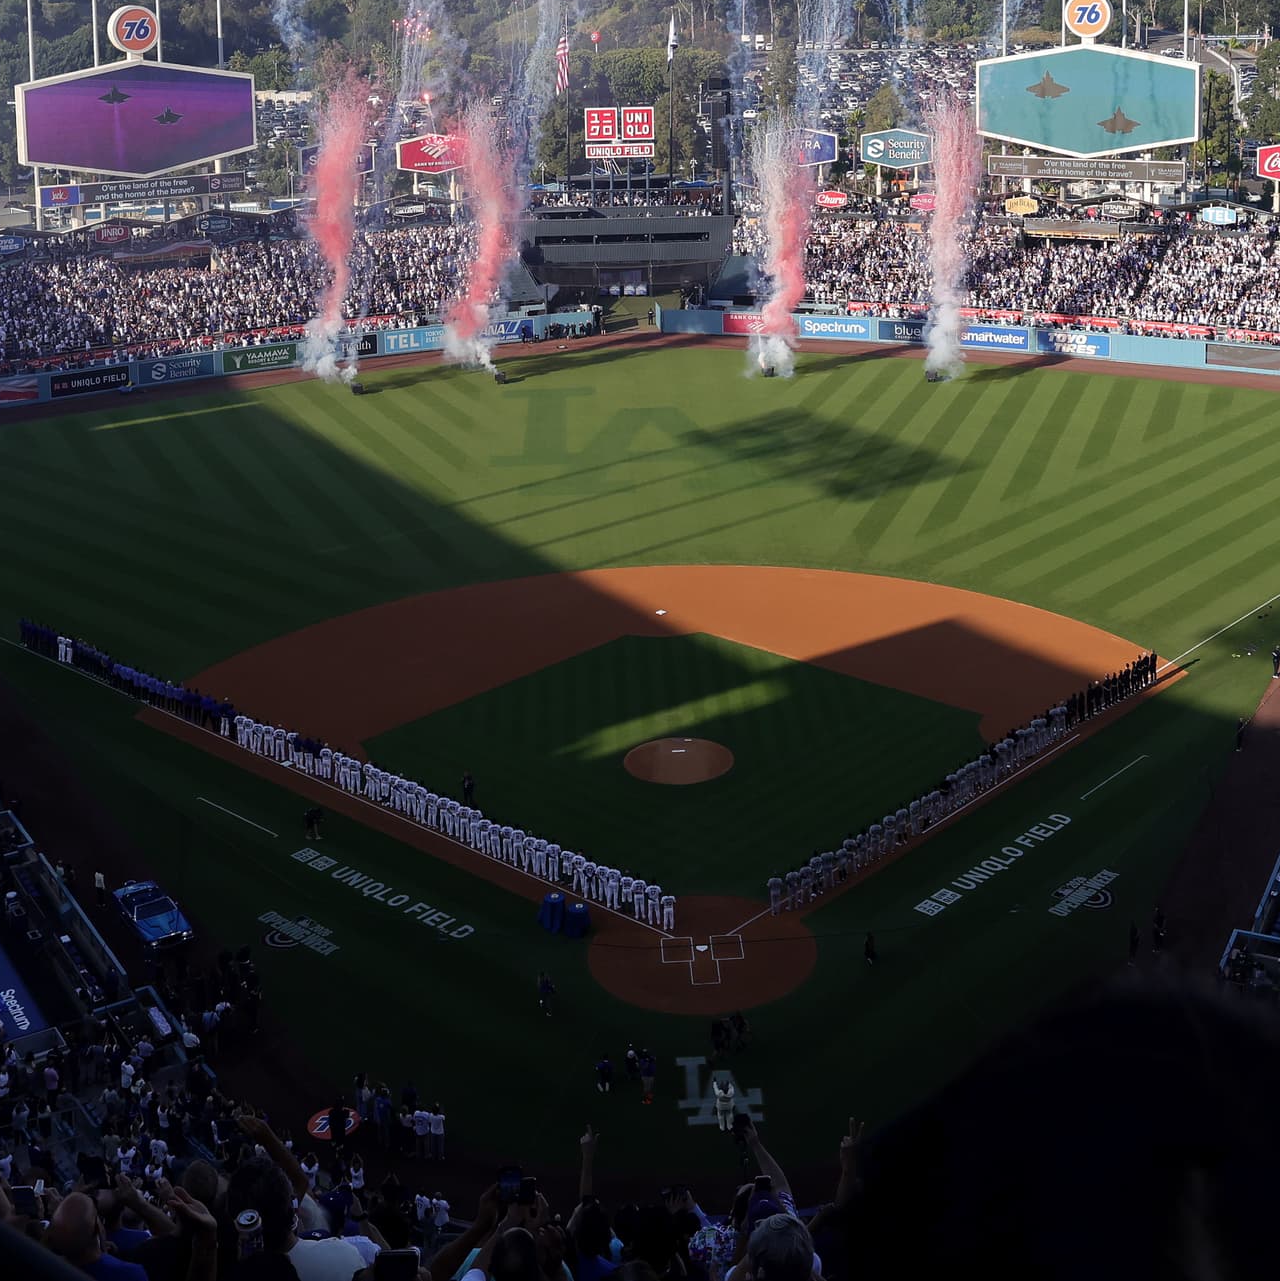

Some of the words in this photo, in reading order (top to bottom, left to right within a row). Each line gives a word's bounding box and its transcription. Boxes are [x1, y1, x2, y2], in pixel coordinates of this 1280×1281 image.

[1075, 4, 1102, 25] 76
[122, 17, 150, 41] 76
[626, 113, 648, 123] UNI
[626, 124, 650, 136] QLO
[888, 138, 926, 151] Security
[589, 147, 622, 157] UNIQLO
[624, 146, 650, 155] FIELD
[888, 149, 921, 160] Benefit
[1073, 160, 1088, 168] land
[1108, 170, 1133, 178] brave?
[101, 183, 117, 192] O'er
[119, 183, 131, 191] the
[132, 182, 149, 190] land
[150, 181, 158, 189] of
[159, 179, 172, 187] the
[173, 178, 188, 187] free
[95, 192, 109, 201] and
[111, 191, 124, 200] the
[125, 190, 145, 199] home
[147, 189, 155, 197] of
[156, 188, 169, 196] the
[170, 186, 195, 195] brave?
[817, 194, 846, 205] Churu
[1207, 211, 1232, 222] TEL
[101, 227, 125, 239] JINRO
[481, 323, 508, 335] ANA
[804, 319, 862, 334] Spectrum
[894, 324, 921, 336] blue
[386, 333, 420, 350] TEL
[1047, 332, 1087, 344] TOYO
[341, 340, 372, 352] Health
[1055, 342, 1097, 355] TIRES
[169, 357, 201, 371] Security
[170, 367, 197, 378] Benefit
[71, 376, 101, 388] UNIQLO
[102, 373, 127, 384] FIELD
[951, 845, 1024, 890] UNIQLO
[1014, 813, 1072, 848] FIELD
[331, 866, 410, 907] UNIQLO
[403, 901, 475, 939] FIELD
[675, 1055, 764, 1126] LA
